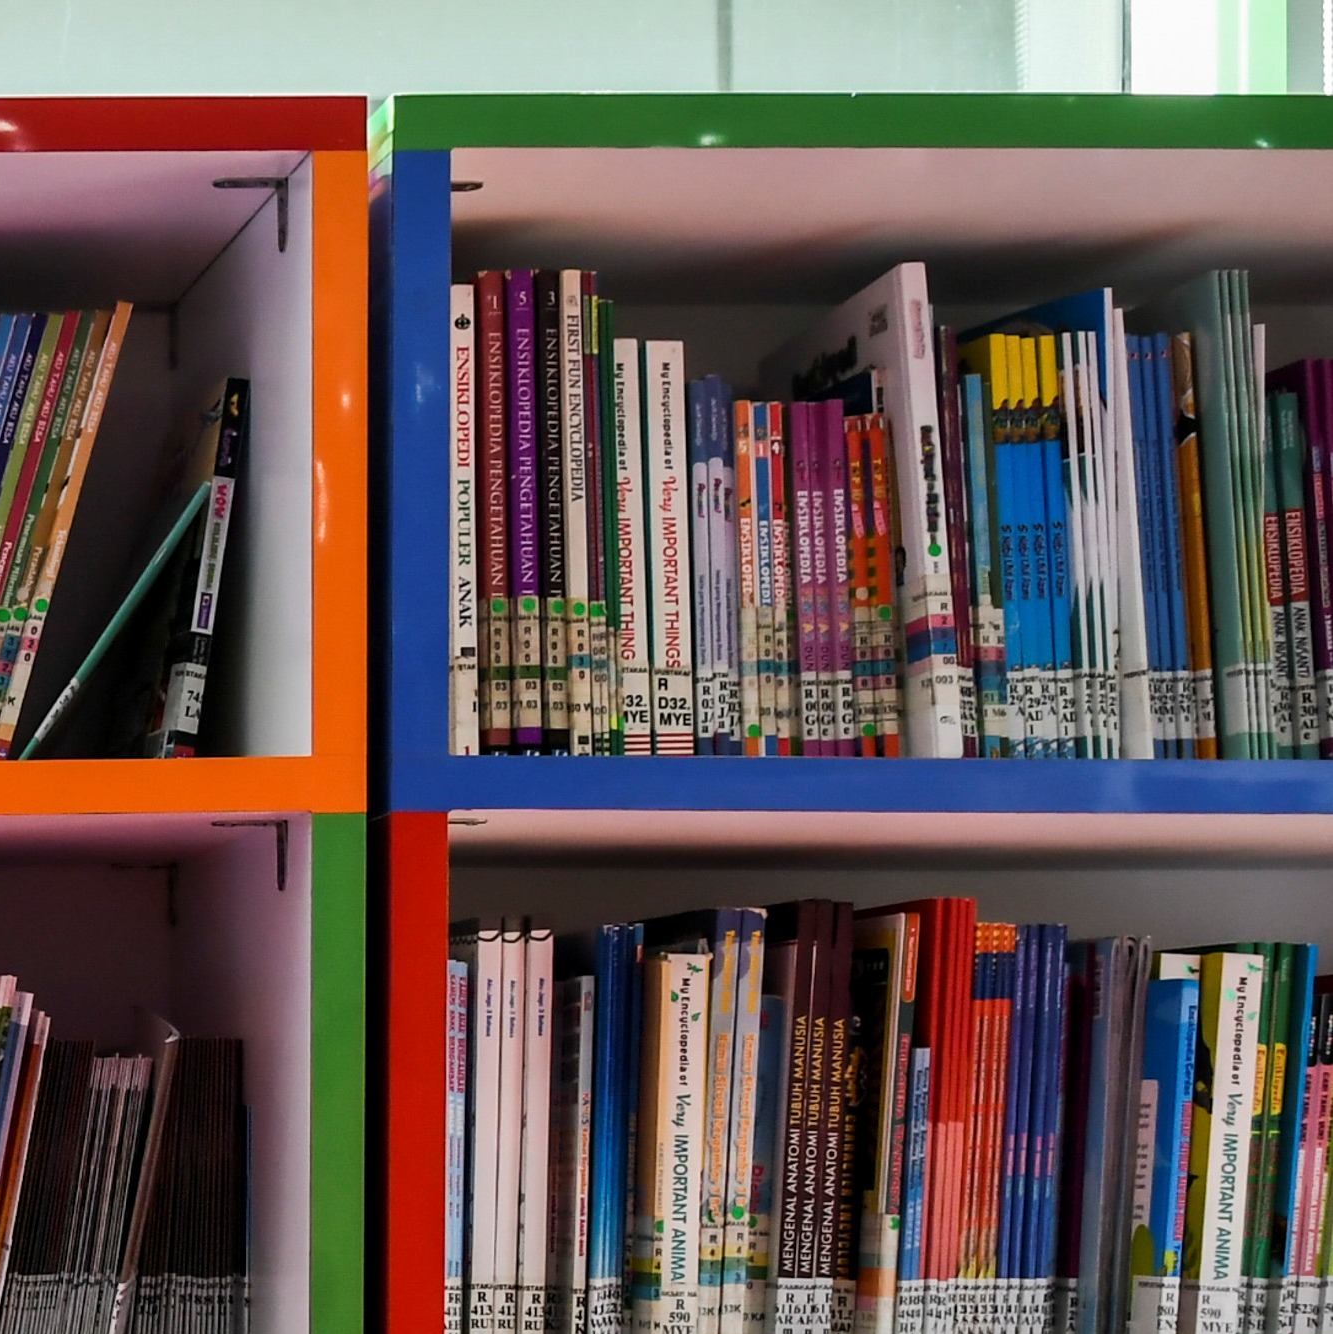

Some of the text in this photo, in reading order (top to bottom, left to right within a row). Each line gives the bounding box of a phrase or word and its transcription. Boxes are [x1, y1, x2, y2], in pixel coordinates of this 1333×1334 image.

[518, 291, 527, 304] 5
[567, 314, 584, 502] FIRST FUN ENCYCLOPEDIA
[738, 440, 747, 454] 5
[772, 442, 780, 454] 4
[456, 346, 473, 628] ENSIKLOPEDI POPULER ANAK
[489, 332, 505, 585] ENSIKLOPEDIA PENGETAHUAN
[517, 329, 535, 588] ENSIKLOPEDIA PENGETAHUAN
[546, 329, 563, 587] ENSIKLOPEDIA PENGETAHUAN
[215, 484, 227, 518] WOW
[615, 362, 636, 660] My Encyclopedia of Very IMPORTANT THING
[659, 362, 682, 669] My Encyclopedia of Very IMPORTANT THINGS
[797, 490, 812, 584] ENSIKLOPEDIA
[813, 491, 827, 585] ENSIKLOPEDIA
[833, 488, 848, 584] ENSIKLOPEDIA
[1266, 516, 1284, 599] ENSIKLOPEDIA
[1285, 511, 1306, 595] ENSIKLOPEDIA
[658, 678, 668, 691] R
[660, 713, 692, 727] MYE
[1237, 977, 1248, 993] My
[1232, 995, 1248, 1072] Encyclopedia
[1221, 1092, 1243, 1127] Very
[1231, 1073, 1241, 1085] of
[671, 977, 692, 1282] My Encyclopedia of Very IMPORTANT ANIMA
[782, 1015, 808, 1272] MENGENAL ANATOMI TUBUH MANUSIA
[799, 1017, 825, 1273] MENGENAL ANATOMI TUBUH MANUSIA
[820, 1018, 846, 1275] MENGENAL ANATOMI TUBUH MANUSIA
[1218, 1133, 1239, 1223] IMPORTANT
[668, 1311, 691, 1324] 590
[675, 1299, 685, 1311] R
[1200, 1308, 1221, 1320] 590
[1201, 1321, 1233, 1334] MYE
